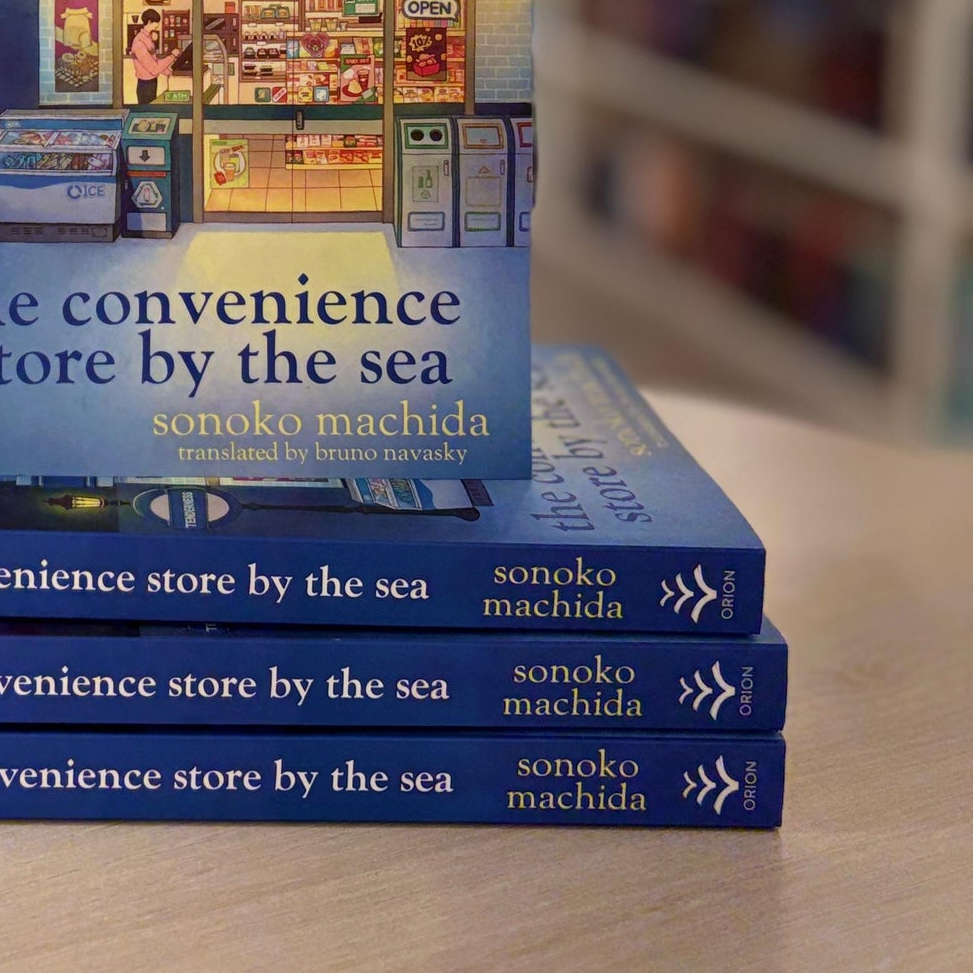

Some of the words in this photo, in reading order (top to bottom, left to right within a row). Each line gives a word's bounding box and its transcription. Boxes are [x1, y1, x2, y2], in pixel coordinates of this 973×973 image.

[407, 1, 451, 15] OPEN
[83, 185, 105, 197] ICE
[62, 273, 461, 325] convenience
[139, 330, 215, 398] by
[239, 330, 337, 385] the
[360, 345, 453, 385] sea
[153, 400, 302, 437] sonoko
[316, 400, 489, 437] machida
[178, 443, 278, 461] translated
[284, 443, 309, 464] by
[315, 443, 377, 461] bruno
[383, 443, 468, 464] navasky
[531, 491, 595, 531] the
[582, 466, 653, 523] store
[146, 568, 236, 595] store
[248, 563, 293, 604] by
[305, 565, 363, 598] the
[375, 576, 429, 599] sea
[494, 557, 616, 586] sonoko
[483, 589, 623, 619] machida
[721, 570, 736, 620] ORION
[168, 673, 257, 698] store
[269, 666, 314, 705] by
[326, 667, 384, 700] the
[395, 677, 449, 700] sea
[513, 655, 635, 684] sonoko
[503, 688, 643, 717] machida
[739, 666, 754, 717] ORION
[173, 767, 262, 791] store
[274, 759, 319, 798] by
[331, 760, 389, 793] the
[400, 769, 454, 793] sea
[517, 749, 639, 778] sonoko
[507, 781, 647, 811] machida
[743, 760, 758, 811] ORION
